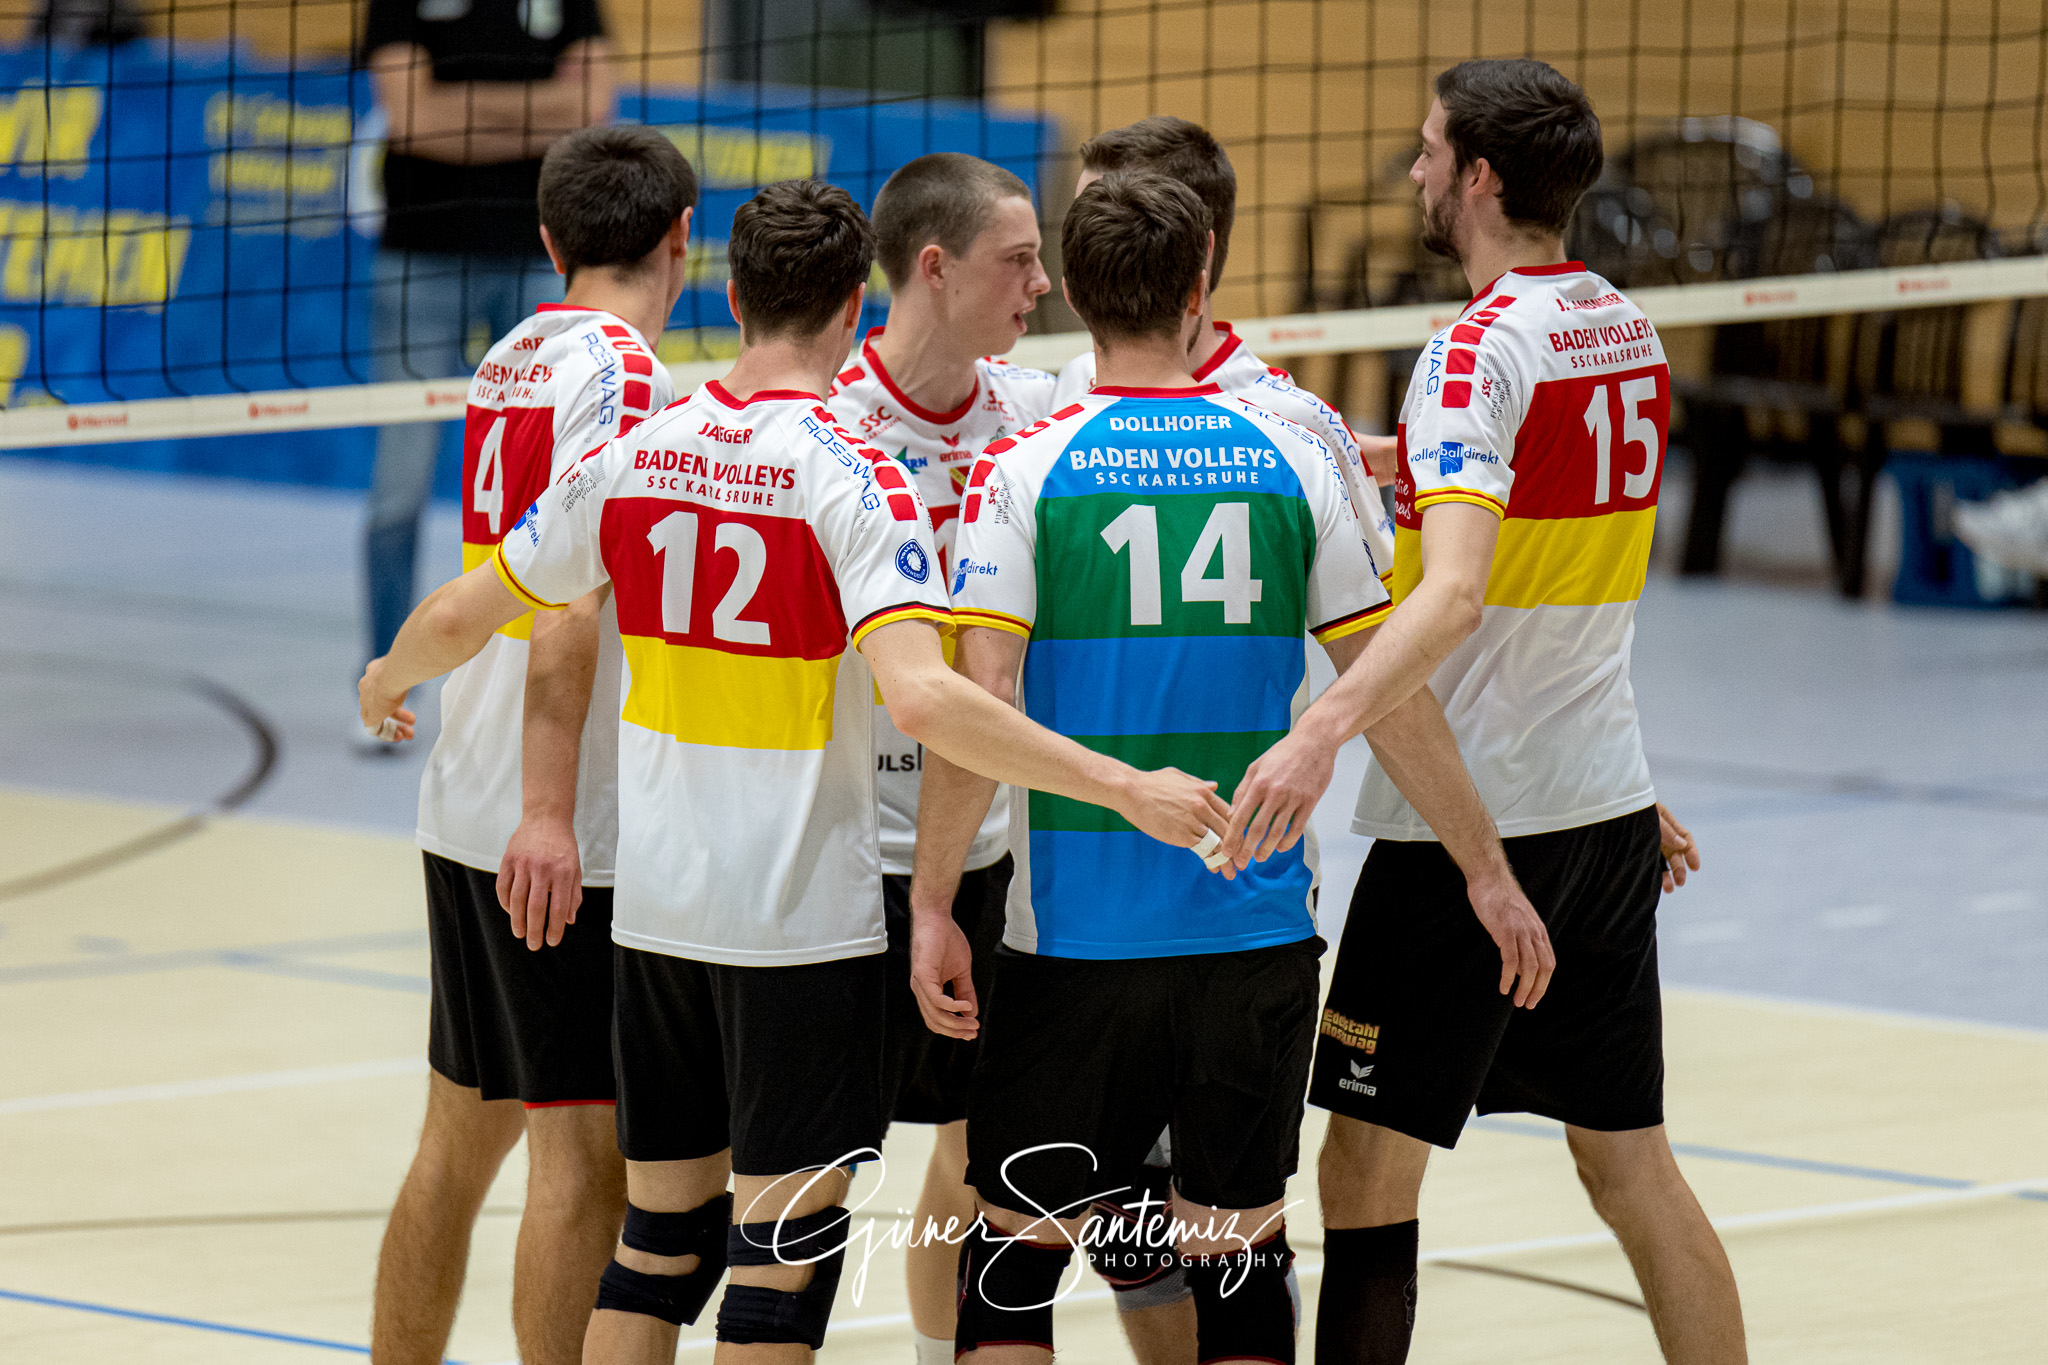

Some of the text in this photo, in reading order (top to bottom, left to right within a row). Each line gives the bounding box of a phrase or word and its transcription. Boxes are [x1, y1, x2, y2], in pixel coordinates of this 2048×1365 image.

[1549, 318, 1655, 352] BADEN VOLLEYS
[1571, 348, 1654, 369] SSC KARLSRUHE
[1481, 376, 1493, 398] SSC
[859, 405, 893, 433] SSC
[1109, 415, 1233, 432] DOLLHOFER
[698, 422, 754, 445] JAEGER
[1583, 375, 1660, 506] 15
[940, 449, 973, 463] erima
[1069, 446, 1277, 471] BADEN VOLLEYS
[1410, 443, 1500, 465] volleyballdirekt
[473, 416, 508, 534] 4
[634, 450, 796, 490] BADEN VOLLEYS
[1095, 471, 1259, 487] SSC KARLSRUHE
[646, 475, 775, 507] SSC KARLSRUHE
[1100, 502, 1263, 626] 14
[646, 510, 772, 647] 12
[1338, 1077, 1378, 1097] erima
